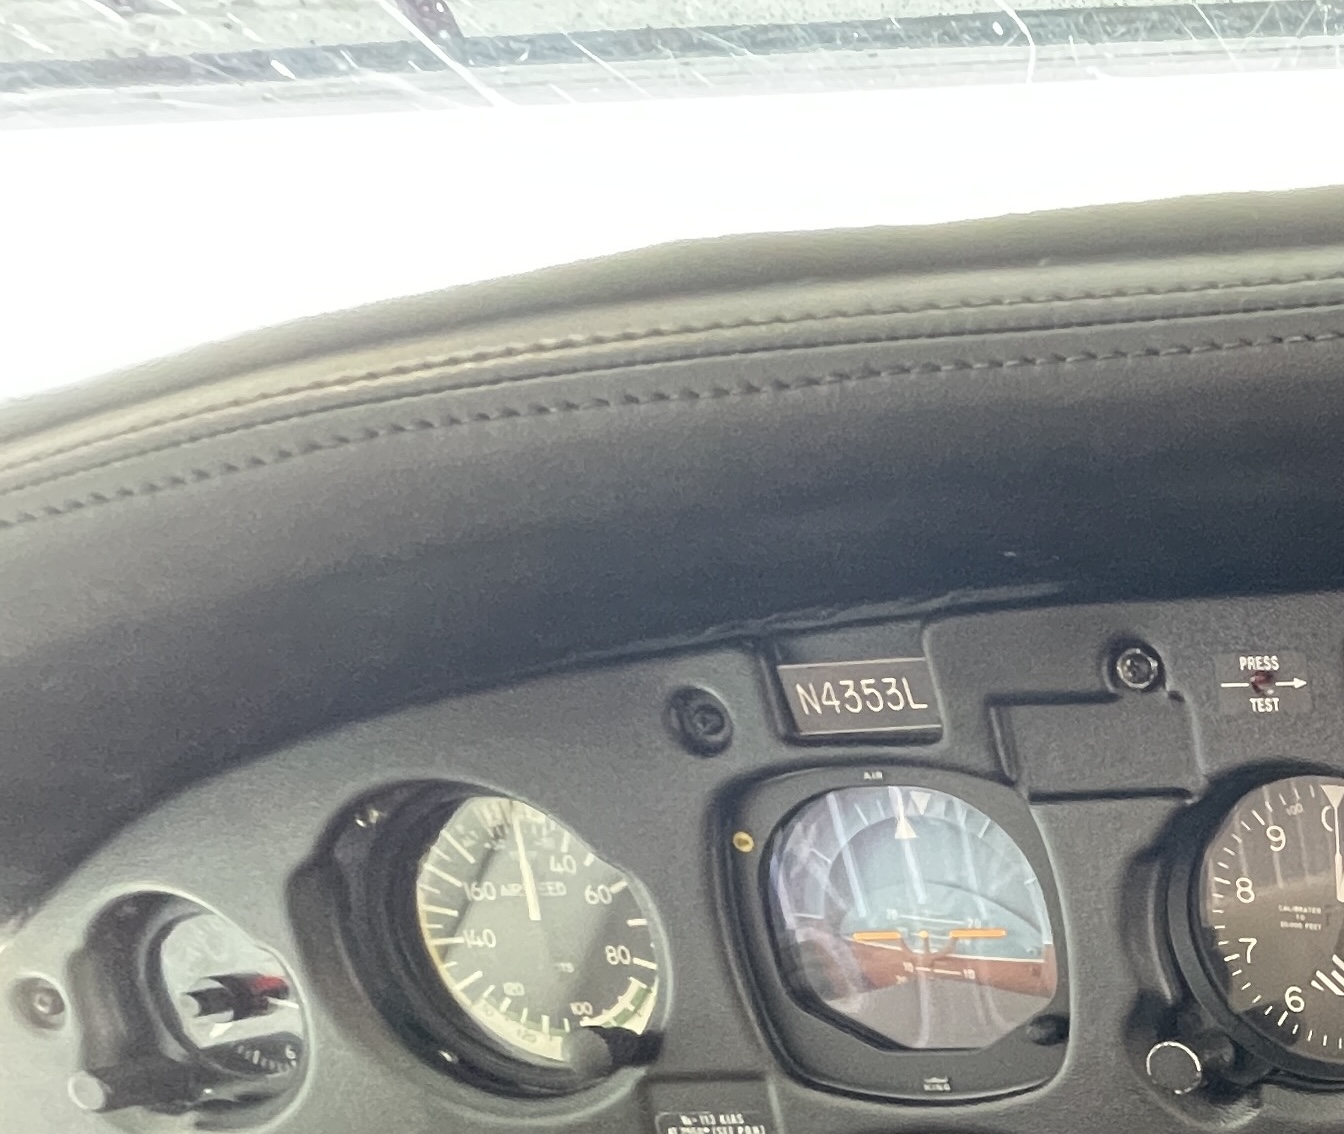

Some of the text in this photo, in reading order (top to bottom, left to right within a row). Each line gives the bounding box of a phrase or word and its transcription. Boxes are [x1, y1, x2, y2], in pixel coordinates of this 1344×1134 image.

[1239, 656, 1279, 671] PRESS
[795, 676, 928, 716] N4353L
[1249, 698, 1280, 713] TEST
[1266, 825, 1286, 852] 9
[584, 884, 612, 904] 60
[1235, 877, 1256, 903] 8
[605, 945, 631, 966] 80
